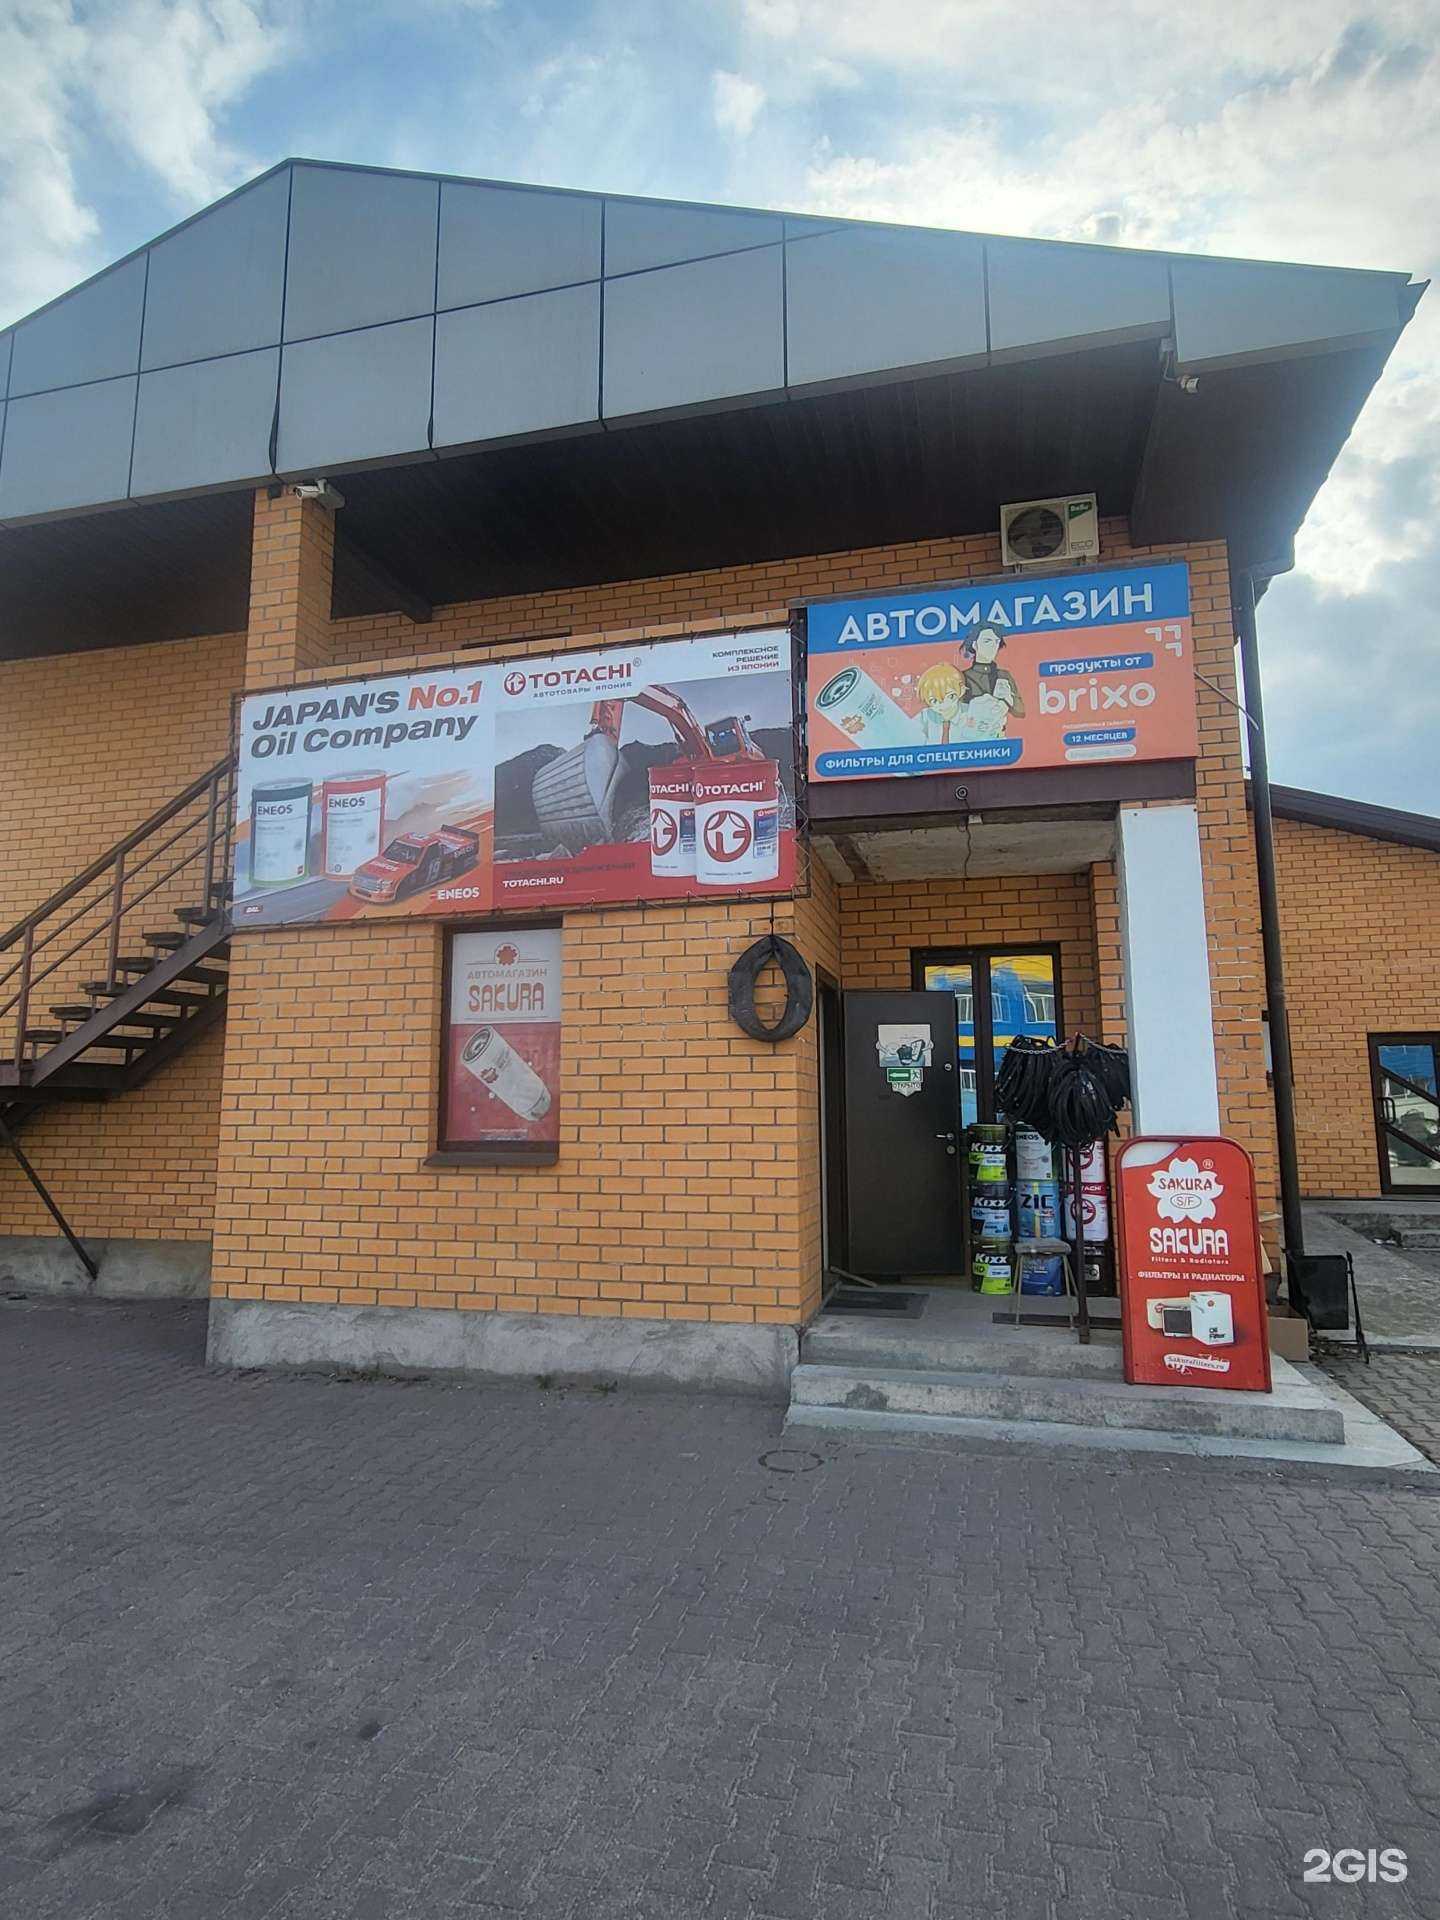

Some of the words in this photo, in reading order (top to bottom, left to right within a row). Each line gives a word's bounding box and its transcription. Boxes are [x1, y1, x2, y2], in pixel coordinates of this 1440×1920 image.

[837, 583, 1153, 644] АВТОМАГАЗИН
[713, 645, 779, 658] КОМПЛЕКСНОЕ
[736, 653, 779, 663] РЕШЕНИЕ
[728, 664, 739, 672] ИЗ
[740, 661, 779, 671] ЯПОНИИ
[1049, 659, 1120, 674] продукты
[1124, 656, 1142, 666] от
[529, 662, 632, 689] TOTACHI
[534, 686, 591, 698] АВТОТОВАРЫ
[1039, 678, 1156, 714] brixo
[252, 691, 399, 731] JAPAN'S
[408, 680, 482, 711] No.1
[251, 731, 296, 759] Oil
[303, 715, 479, 752] Company
[1084, 731, 1128, 742] МЕСЯЦЕВ
[825, 756, 884, 770] ФИЛЬТРЫ
[888, 754, 913, 766] ДЛЯ
[917, 746, 1010, 763] СПЕЦТЕХНИКИ
[704, 781, 763, 795] TOTACHI
[256, 804, 293, 815] ENEOS
[329, 797, 365, 808] ENEOS
[502, 876, 564, 888] TOTACHI.RU
[437, 887, 480, 900] ENEOS
[467, 968, 547, 980] АВТОМАГАЗИН
[468, 982, 545, 1013] SAKURA
[1158, 1177, 1213, 1191] SAKURA
[1021, 1194, 1054, 1209] ZIC
[1150, 1227, 1229, 1255] SAKURA
[1138, 1271, 1181, 1280] ФИЛЬТРЫ
[1183, 1272, 1190, 1280] И
[1191, 1272, 1245, 1282] РАДИАТОРЫ
